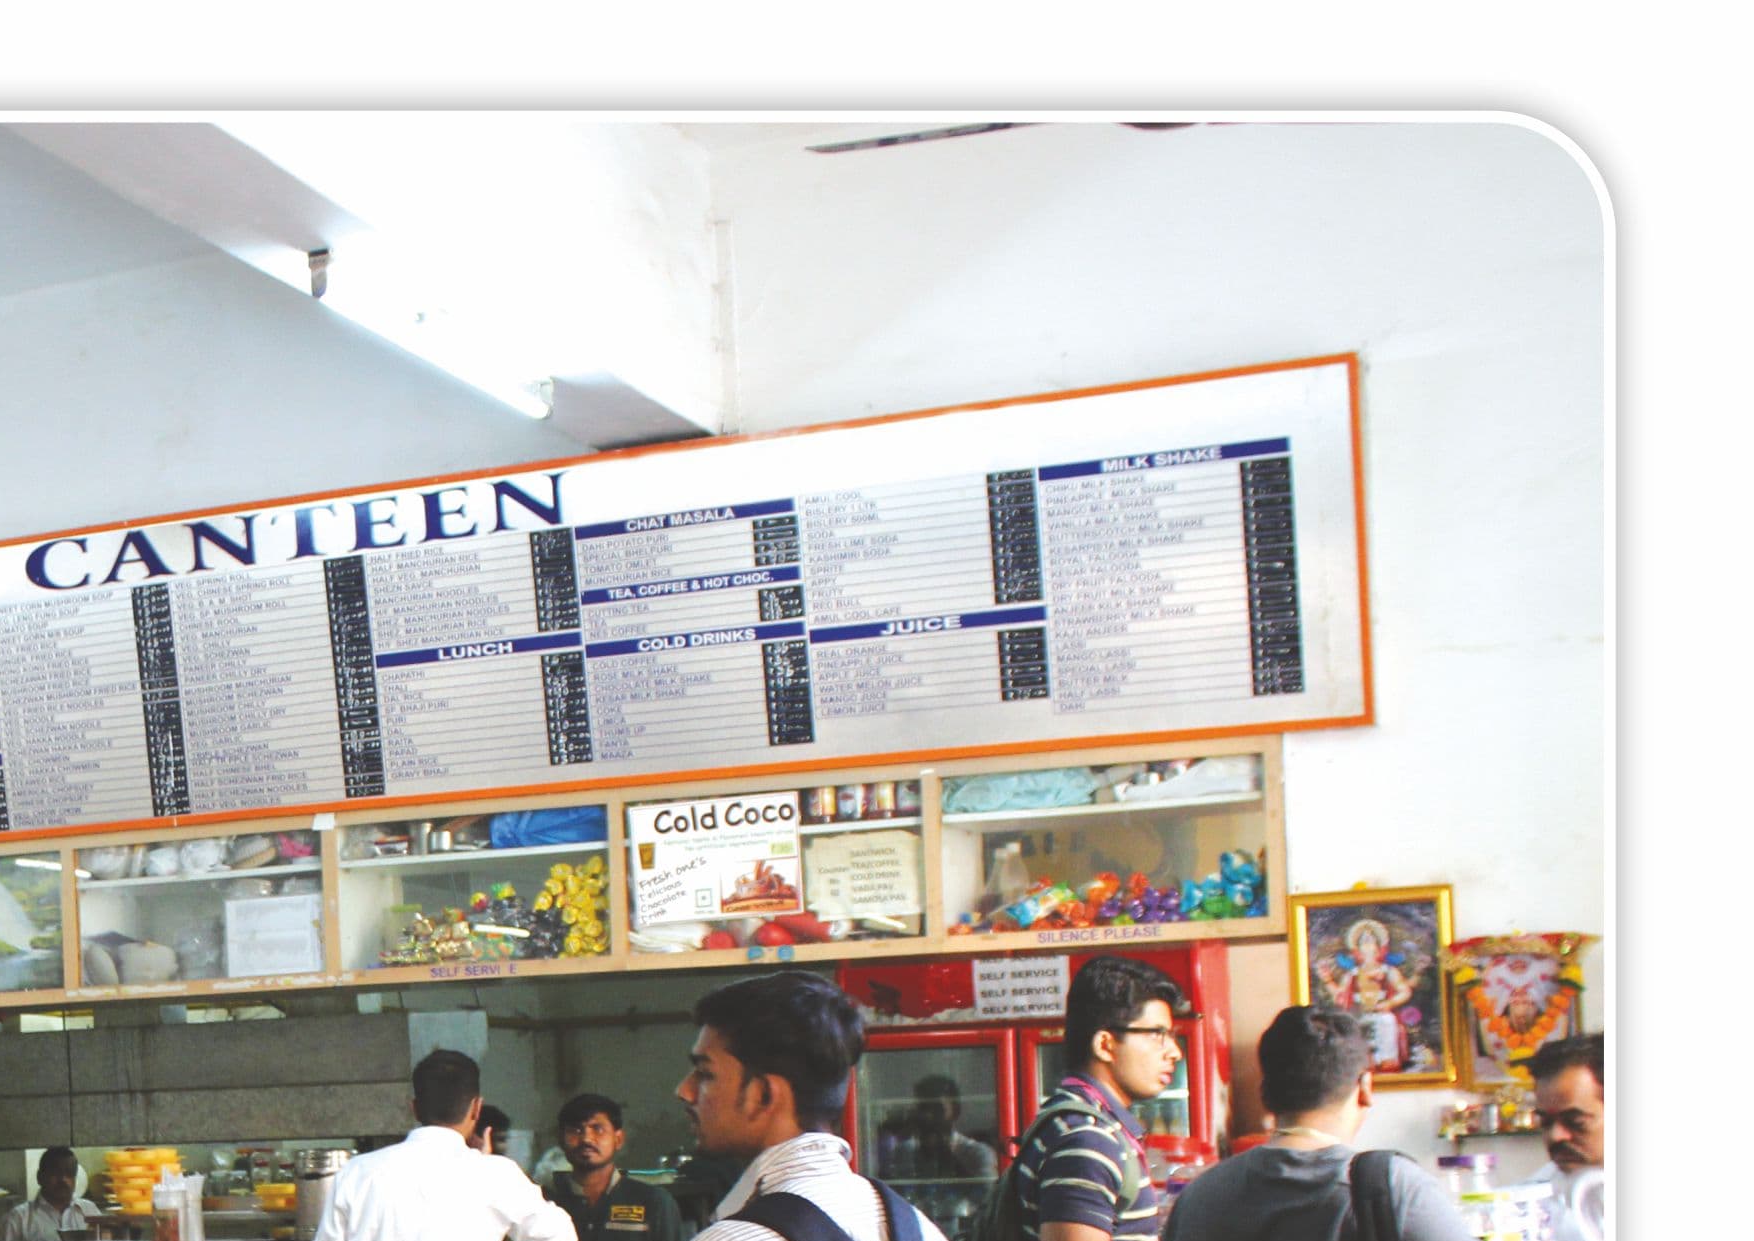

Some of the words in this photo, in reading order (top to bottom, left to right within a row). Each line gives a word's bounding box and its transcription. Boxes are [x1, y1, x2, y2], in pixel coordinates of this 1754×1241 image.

[1102, 455, 1149, 473] MILK
[1153, 445, 1222, 466] SHAKE
[625, 515, 666, 532] CHAT
[669, 506, 734, 526] MASALA
[24, 471, 568, 591] CANTEEN
[608, 586, 636, 601] TEA,
[638, 580, 688, 597] COFFEE
[690, 578, 701, 591] &
[703, 575, 729, 589] HOT
[732, 569, 774, 585] CHOC.
[881, 615, 962, 635] JUICE
[638, 635, 686, 652] COLD
[690, 627, 756, 646] DRINKS
[438, 640, 513, 660] LUNCH
[654, 803, 718, 834] Cold
[724, 800, 795, 827] Coco
[1037, 928, 1099, 943] SILENCE
[1103, 926, 1162, 940] PLEASE
[430, 966, 461, 978] SELF
[464, 963, 517, 977] SERVIE
[979, 972, 1006, 981] SELF
[1010, 968, 1059, 979] SERVICE
[980, 989, 1007, 998] SELF
[1011, 985, 1061, 996] SERVICE
[981, 1005, 1008, 1015] SELF
[1012, 1001, 1062, 1013] SERVICE
